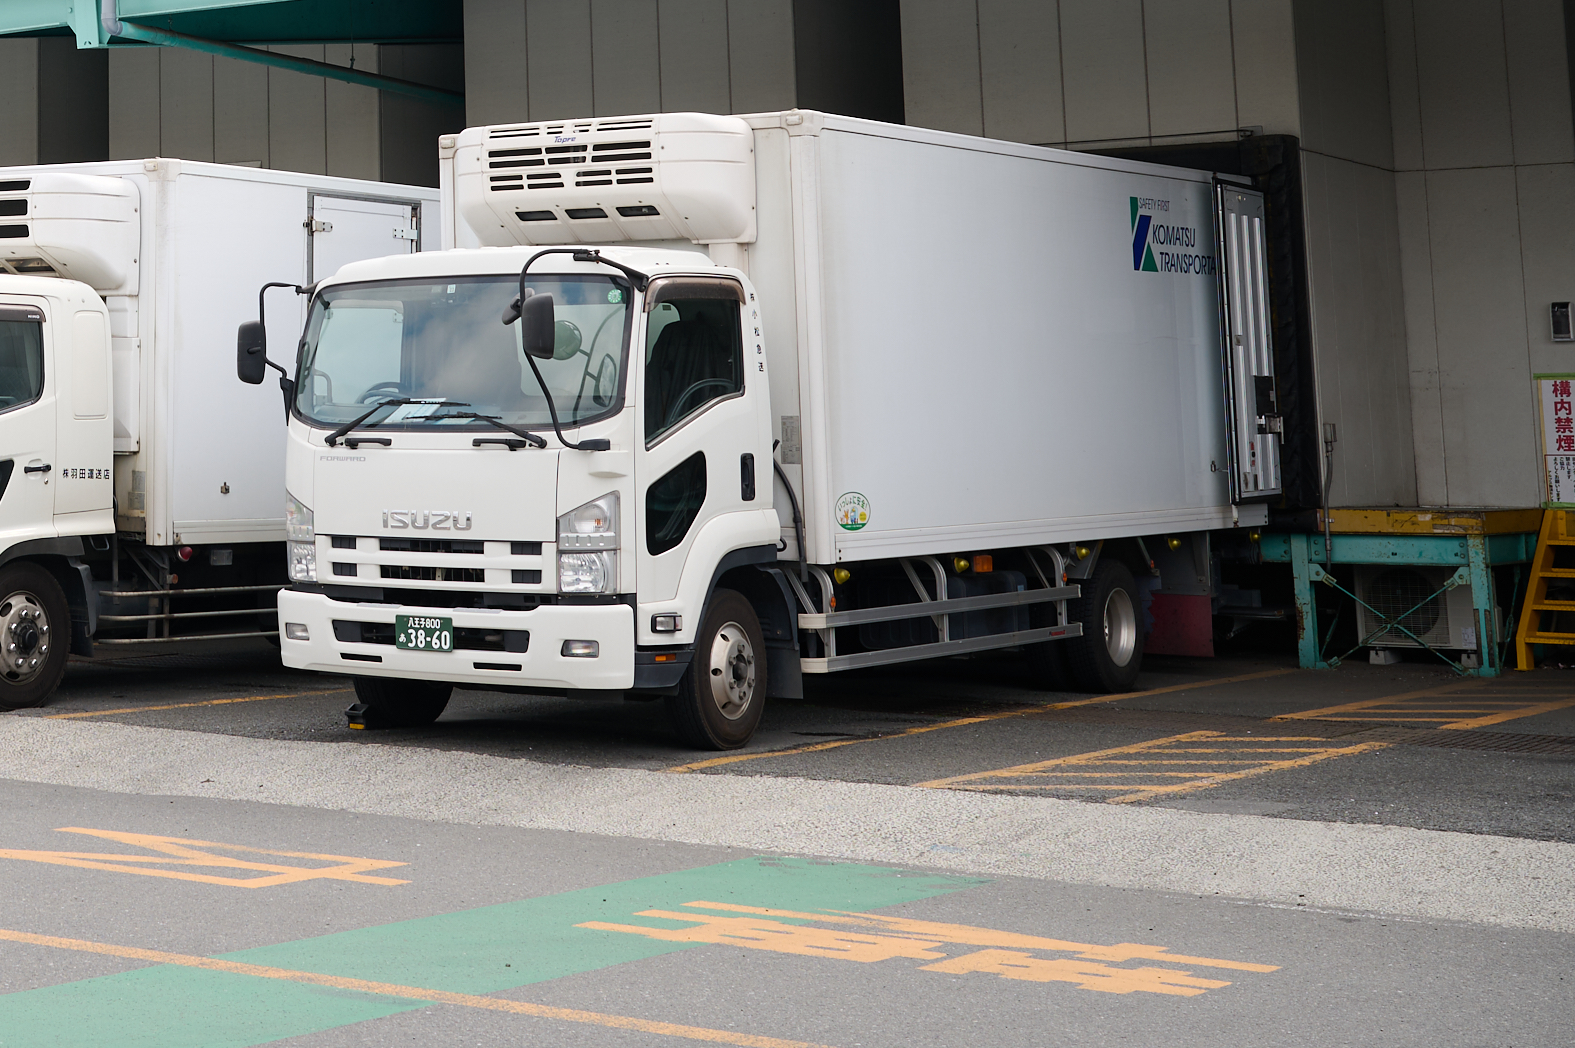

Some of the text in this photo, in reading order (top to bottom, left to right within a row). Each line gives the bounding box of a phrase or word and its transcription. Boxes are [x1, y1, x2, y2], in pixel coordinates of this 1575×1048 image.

[554, 135, 577, 144] Topre
[1138, 197, 1170, 212] SAFETY FIRST
[1152, 224, 1196, 248] KOMATSU
[1552, 380, 1575, 452] 構内禁煙
[382, 508, 473, 531] ISUZU
[407, 617, 441, 629] 八王子800
[398, 628, 451, 650] あ 38-60
